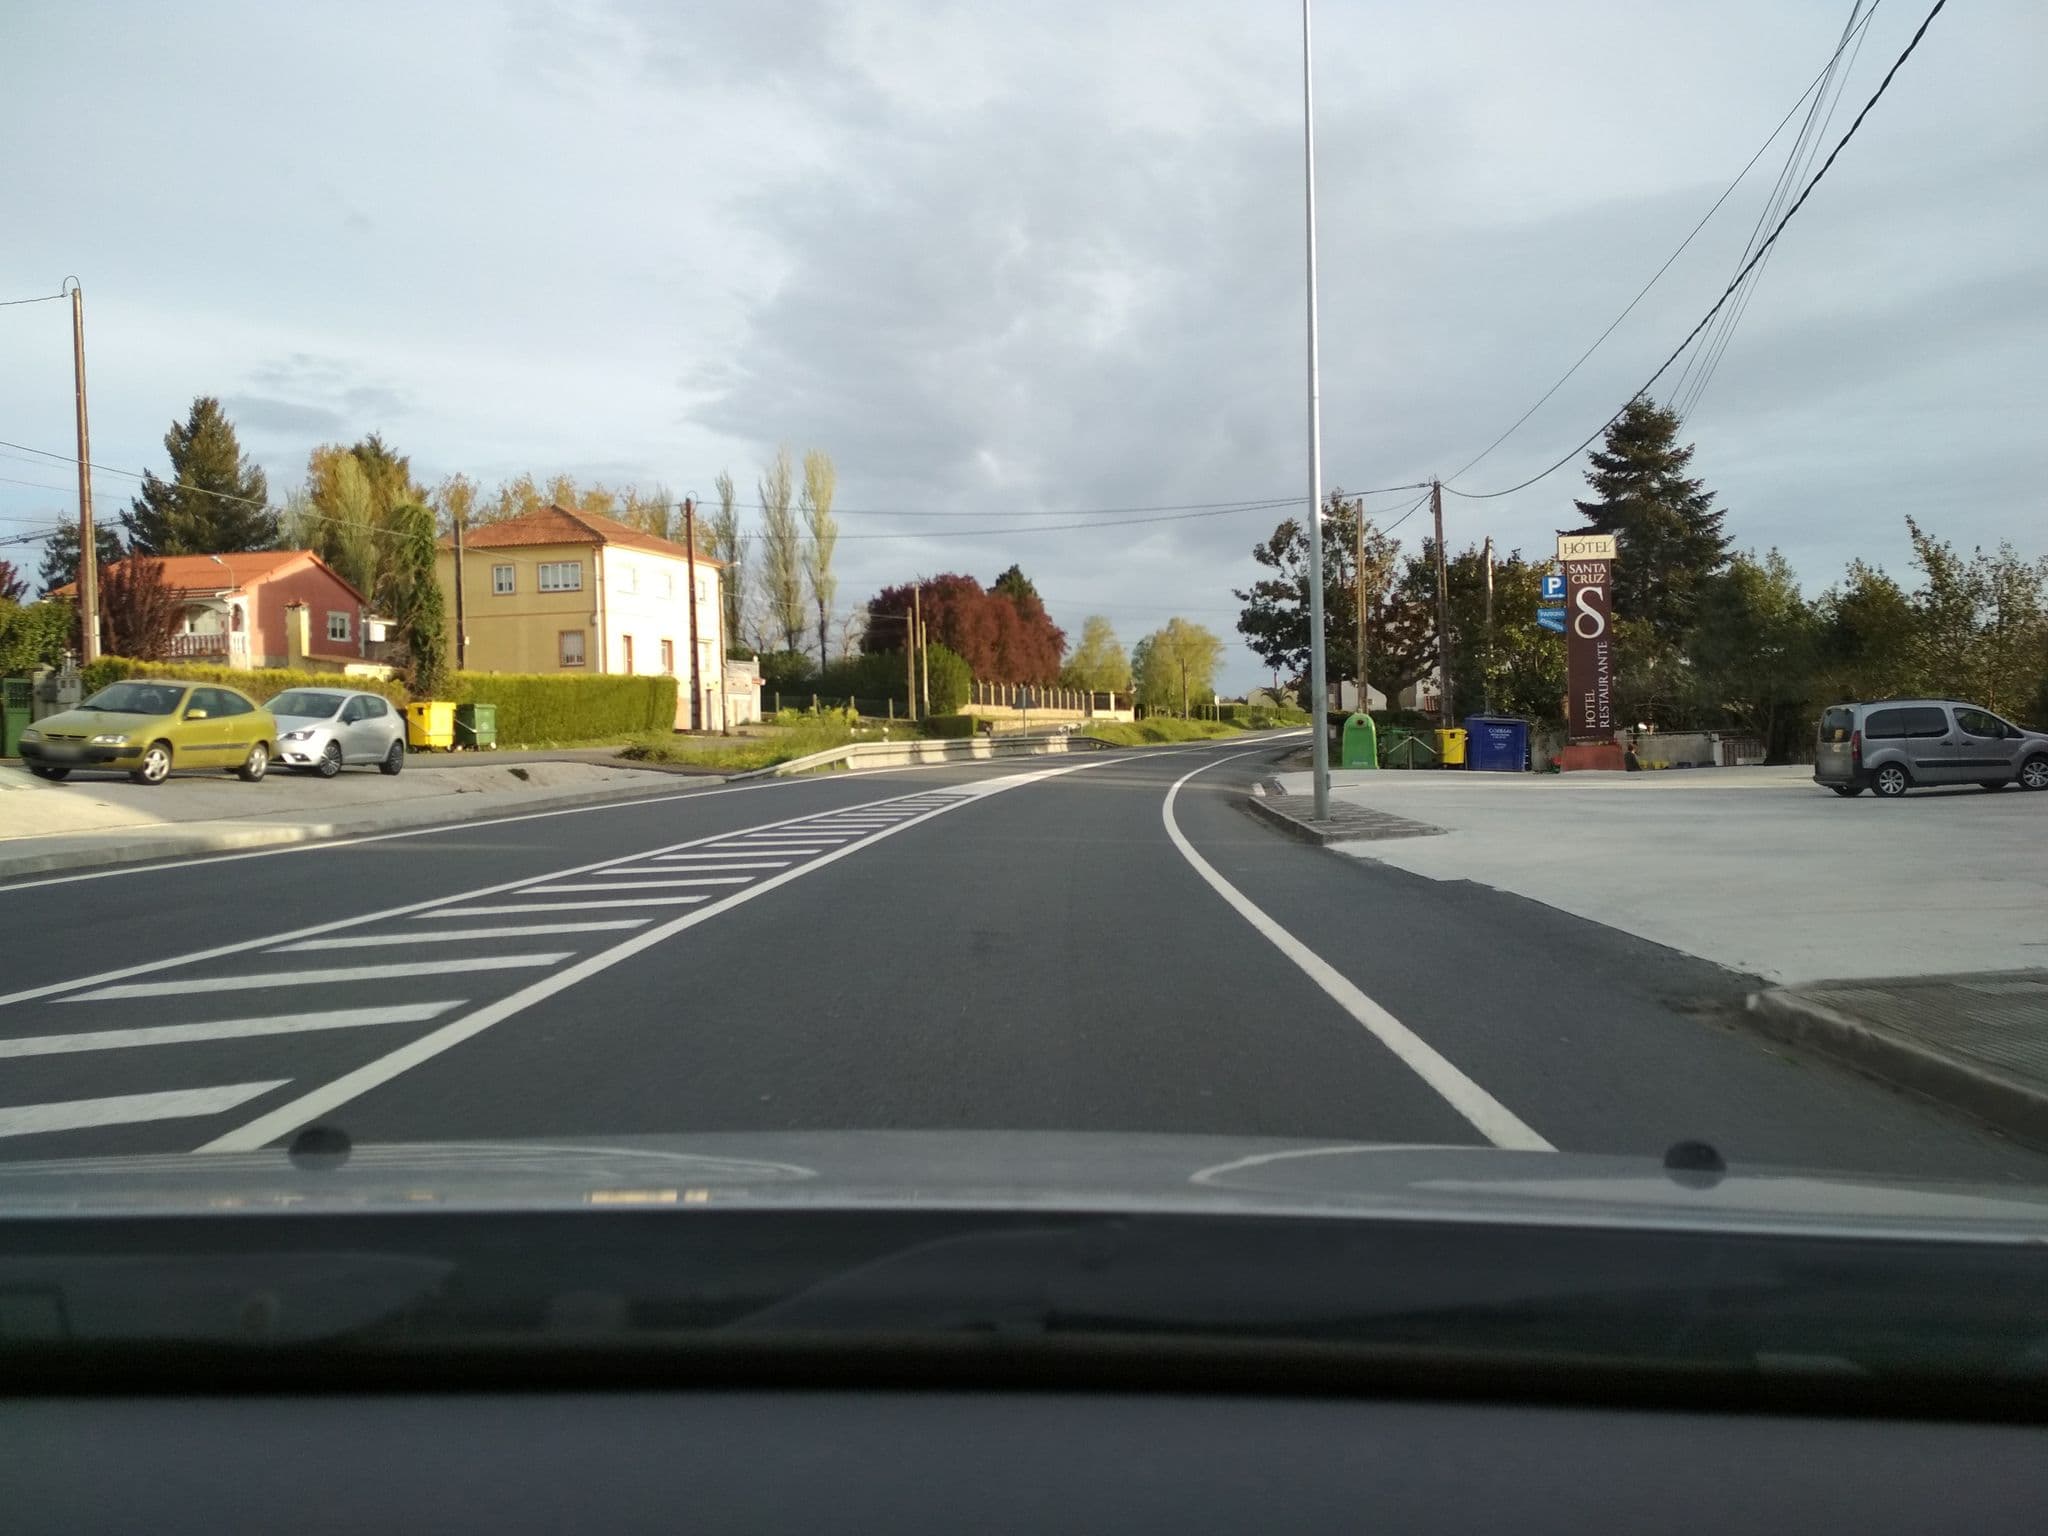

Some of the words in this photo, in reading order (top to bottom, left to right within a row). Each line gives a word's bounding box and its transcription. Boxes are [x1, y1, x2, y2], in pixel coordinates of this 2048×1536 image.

[1563, 542, 1611, 554] HOTEL
[1569, 563, 1607, 574] SANTA
[1549, 577, 1562, 594] P
[1571, 574, 1605, 584] CRUZ
[1597, 640, 1610, 728] RESTAURANTE
[1584, 689, 1596, 728] HOTEL
